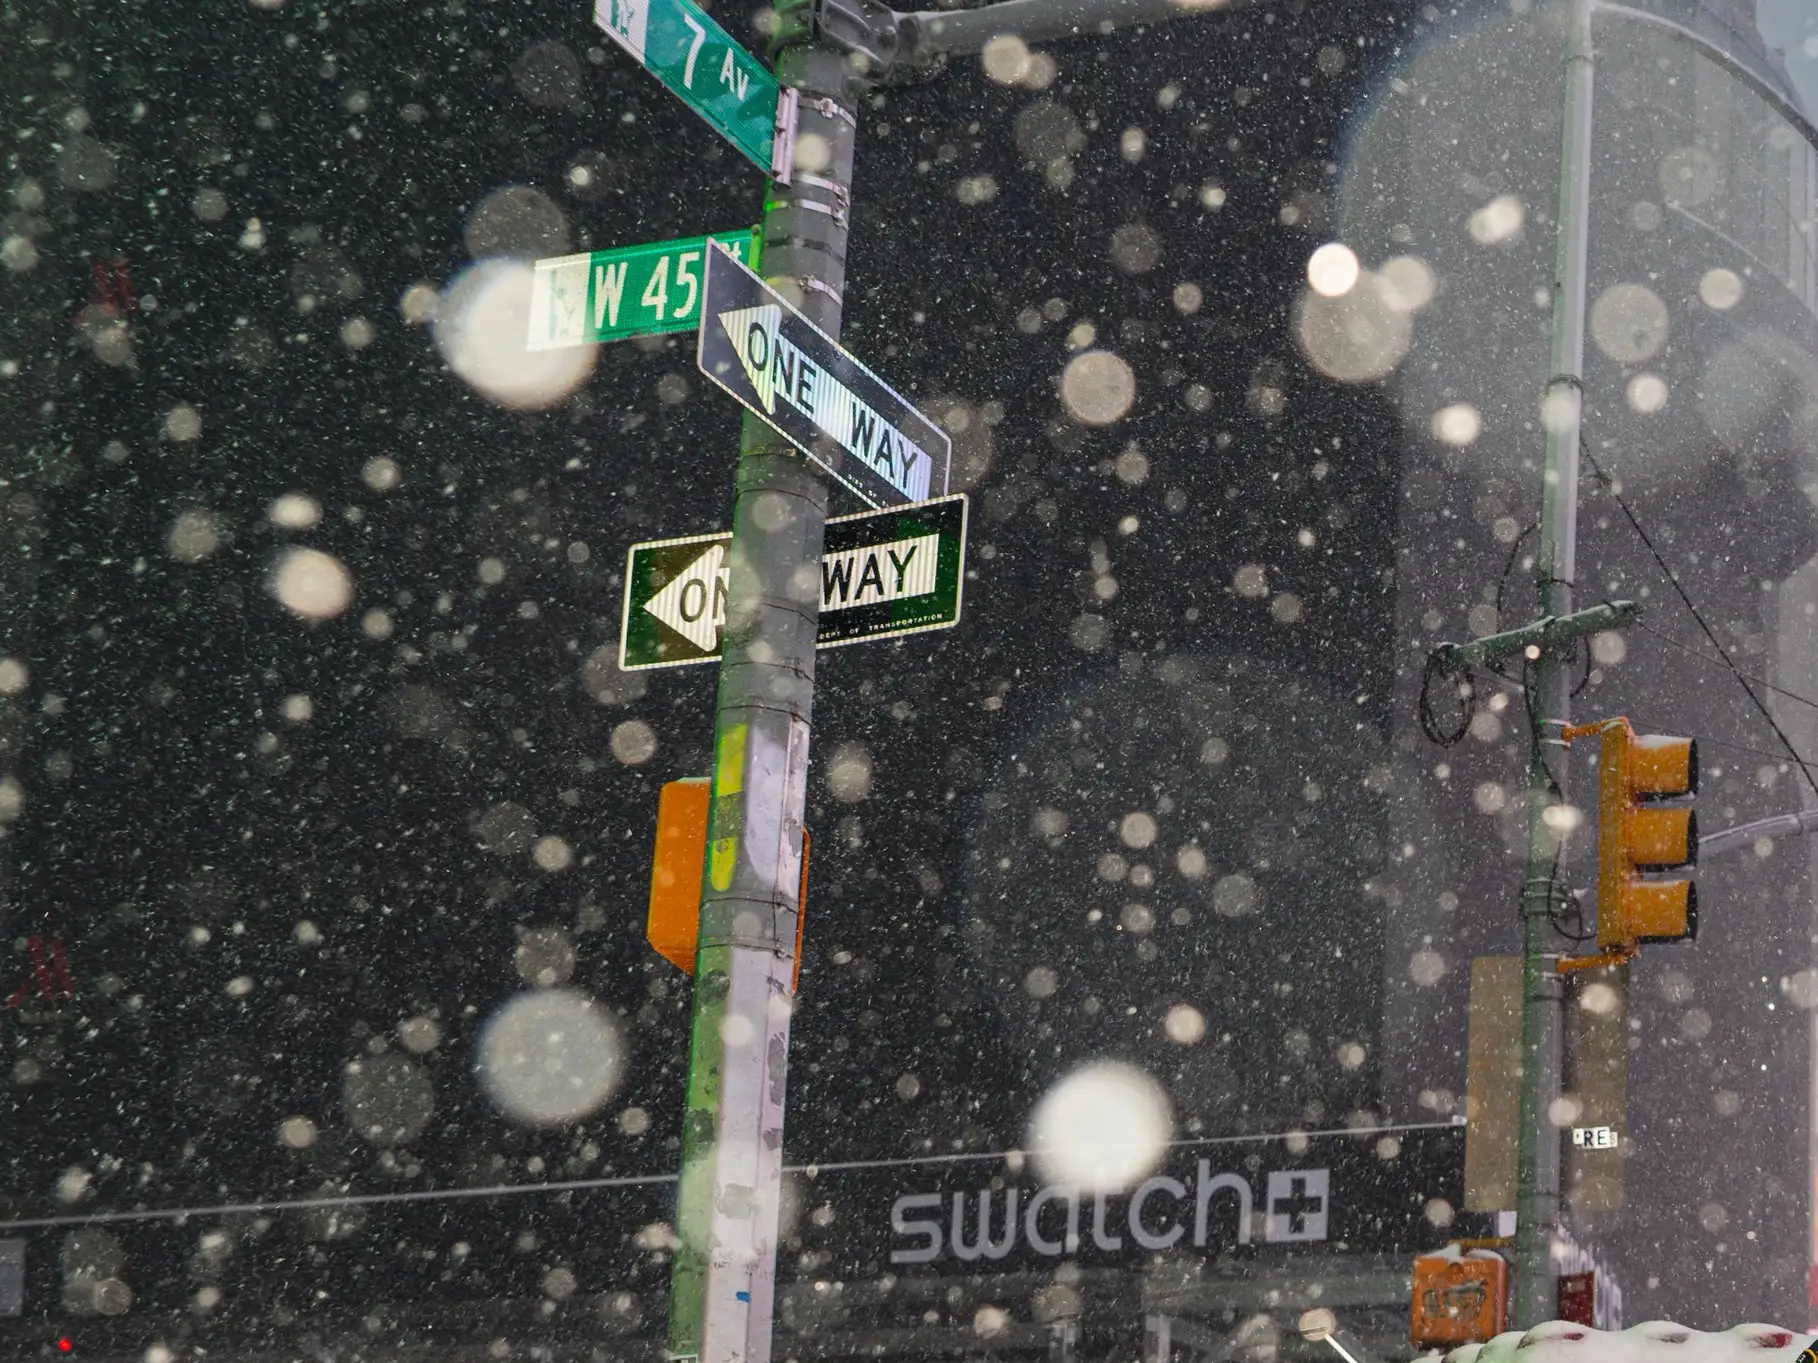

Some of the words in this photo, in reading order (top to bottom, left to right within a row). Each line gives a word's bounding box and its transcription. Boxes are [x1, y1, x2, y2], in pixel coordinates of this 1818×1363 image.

[683, 13, 706, 90] 7
[719, 47, 750, 100] Av
[594, 261, 629, 328] W
[641, 251, 700, 320] 45
[748, 322, 817, 416] ONE
[850, 400, 918, 490] WAY
[679, 575, 730, 623] ON
[821, 545, 918, 605] WAY
[868, 613, 943, 631] TRANSPORTATION
[891, 1159, 1254, 1264] swatch
